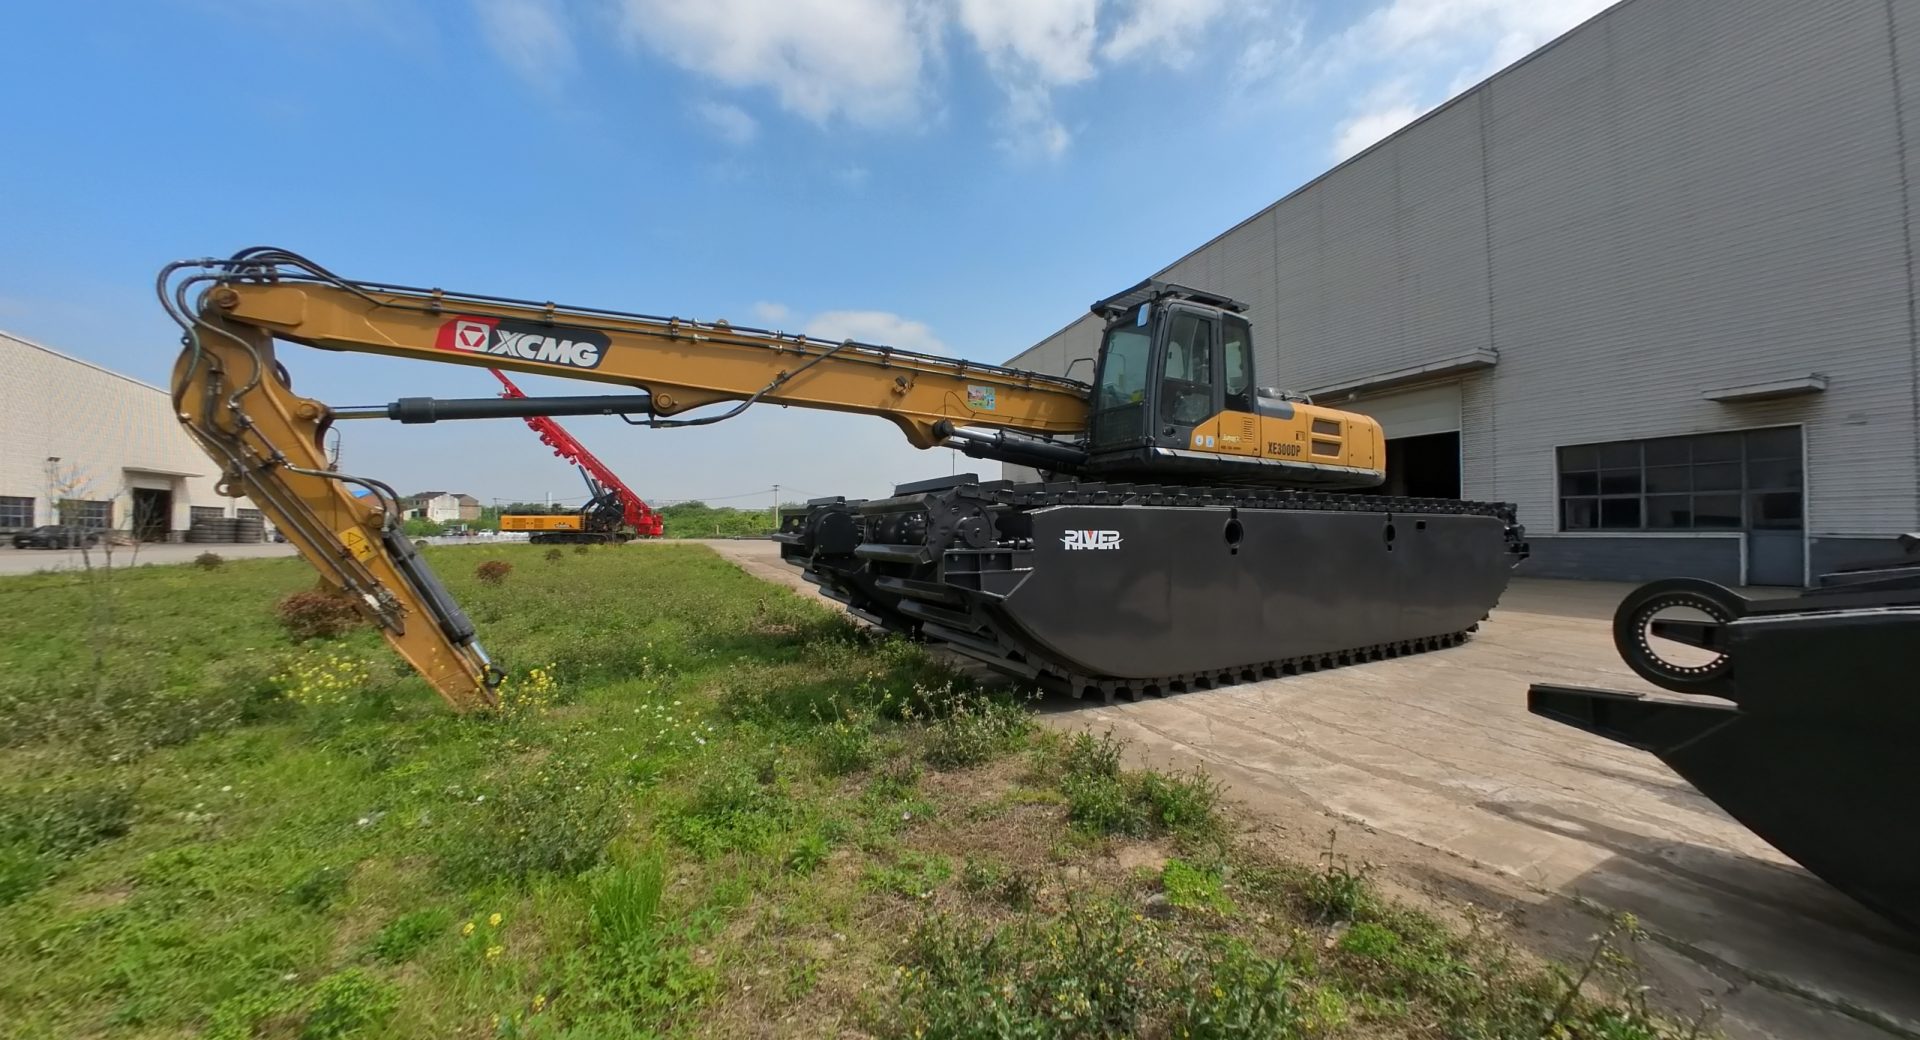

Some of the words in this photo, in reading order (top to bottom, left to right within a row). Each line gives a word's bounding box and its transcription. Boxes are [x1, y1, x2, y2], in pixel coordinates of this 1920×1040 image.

[488, 329, 599, 367] XCMG
[1267, 442, 1302, 457] XE300DP
[1063, 529, 1121, 550] RIVER
